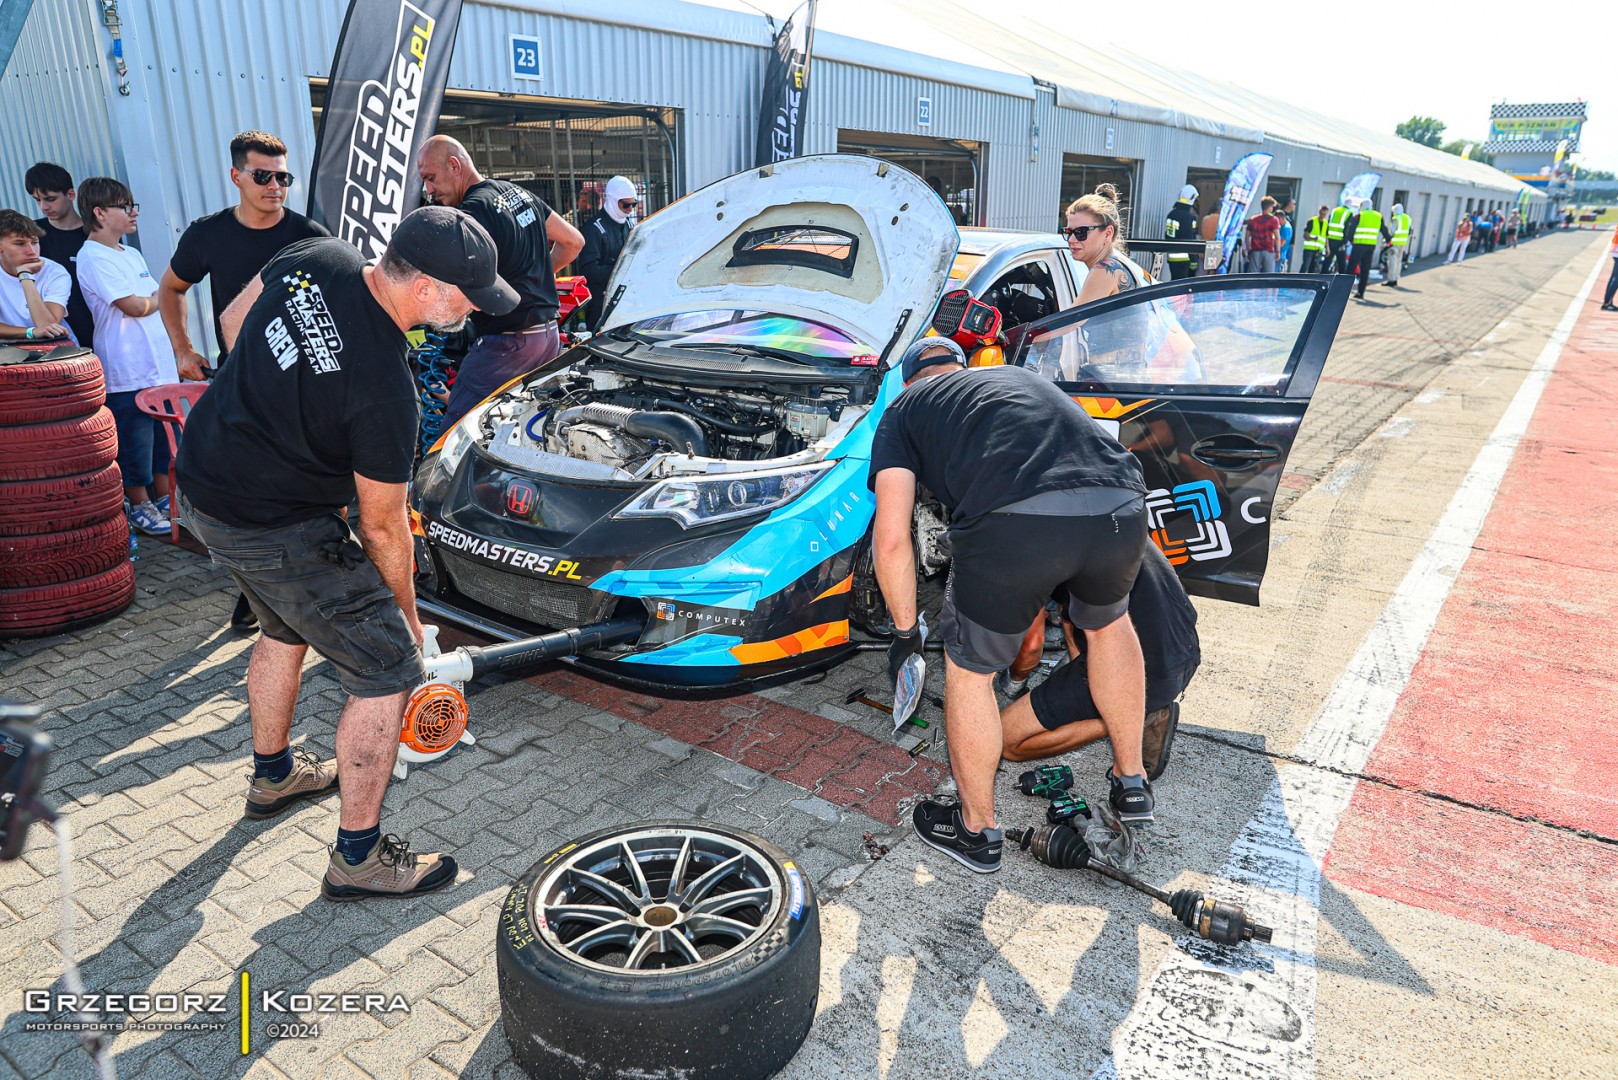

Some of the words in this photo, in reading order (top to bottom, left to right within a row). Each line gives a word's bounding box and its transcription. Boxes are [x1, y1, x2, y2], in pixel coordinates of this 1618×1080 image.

[516, 47, 536, 68] 23
[920, 105, 929, 118] 22
[264, 316, 299, 371] CREW
[285, 299, 305, 336] RACIN
[301, 339, 322, 375] TEAM
[307, 290, 343, 352] SPEED
[428, 520, 582, 580] SPEEDMASTERS.PL
[678, 610, 746, 627] COMPUTEX
